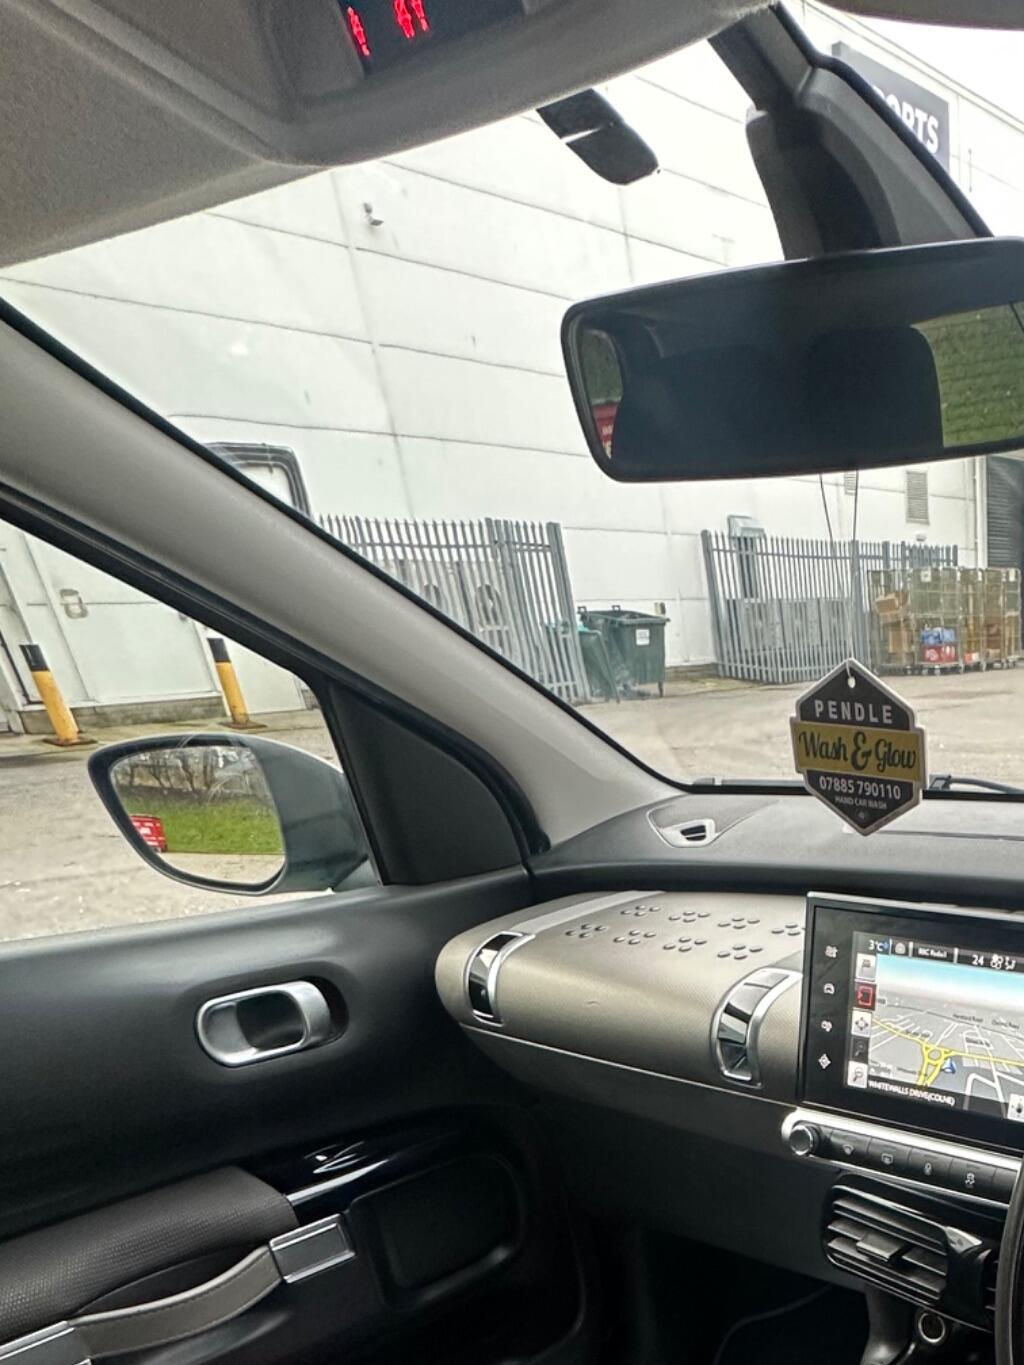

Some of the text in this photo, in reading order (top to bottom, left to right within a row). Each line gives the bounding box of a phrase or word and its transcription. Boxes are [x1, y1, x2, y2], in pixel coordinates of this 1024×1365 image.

[873, 86, 939, 154] ORTS
[814, 700, 893, 724] PENDLE
[798, 731, 916, 773] Wash & Glow
[819, 776, 901, 800] 07885 790110
[972, 954, 985, 966] 24
